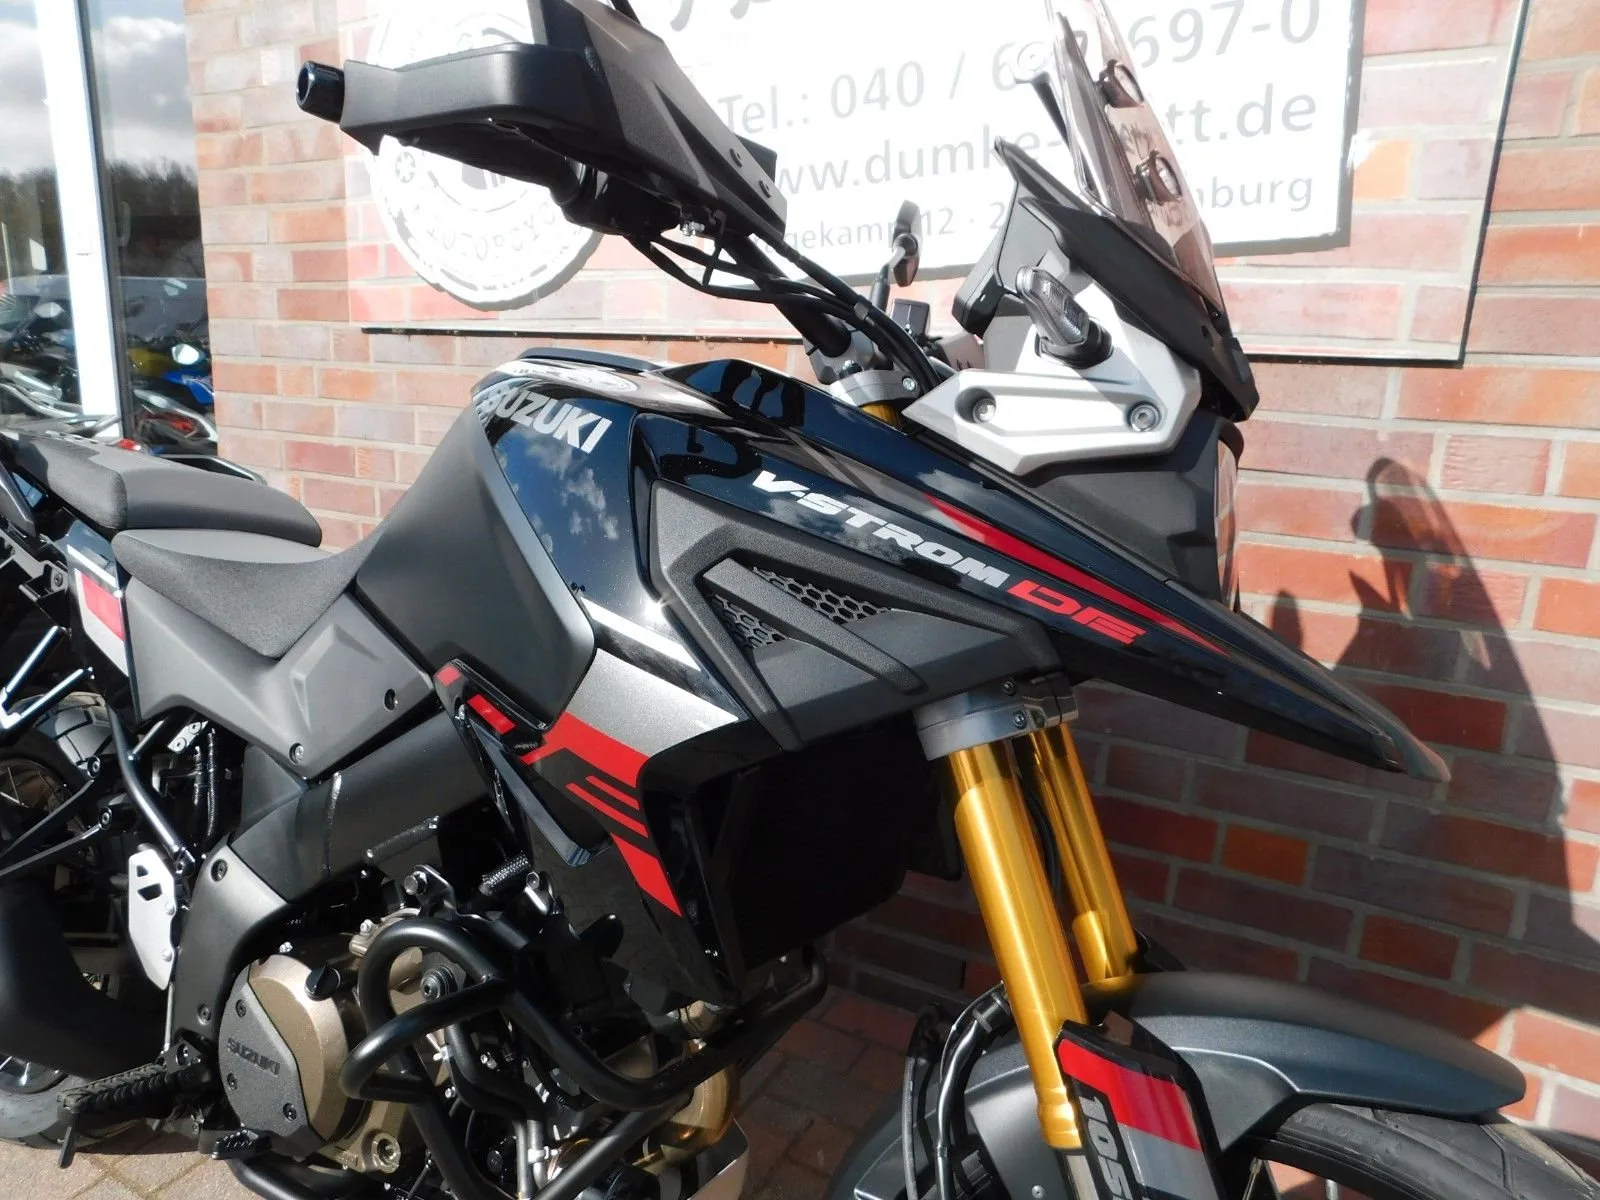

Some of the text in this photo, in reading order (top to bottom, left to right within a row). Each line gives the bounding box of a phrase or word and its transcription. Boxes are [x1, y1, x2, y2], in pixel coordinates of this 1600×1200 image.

[717, 85, 808, 134] Tel.:
[829, 61, 925, 119] 040
[947, 51, 968, 100] /
[752, 469, 1010, 588] V-STROM
[227, 1037, 281, 1076] SUZUKI
[1079, 1096, 1137, 1200] 105
